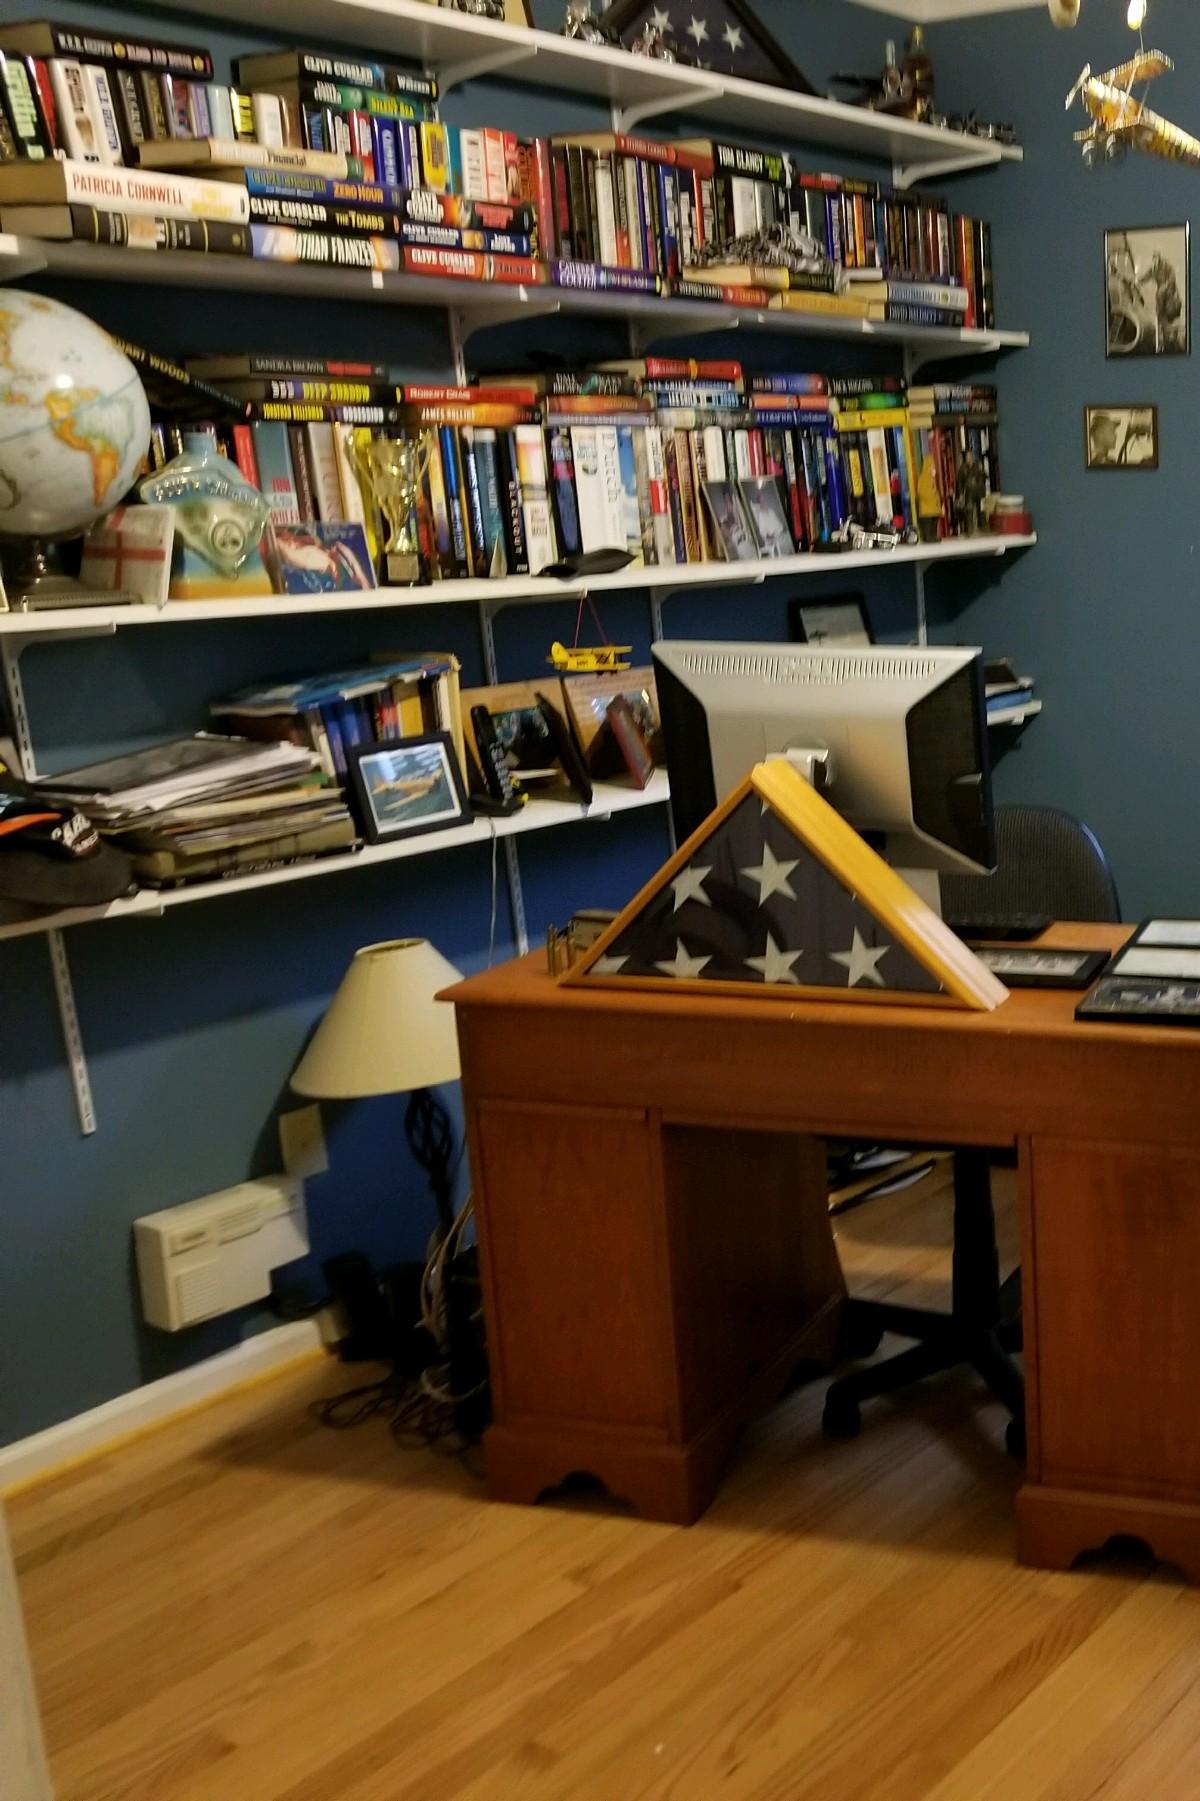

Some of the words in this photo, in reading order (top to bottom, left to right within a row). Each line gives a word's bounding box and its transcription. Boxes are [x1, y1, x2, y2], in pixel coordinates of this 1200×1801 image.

[304, 55, 332, 76] CLIVE
[333, 60, 374, 88] CUSSLER
[268, 152, 307, 167] Financial
[718, 145, 736, 165] TOM
[737, 150, 764, 173] CLANCY
[72, 173, 123, 198] PATRICIA
[127, 180, 184, 206] CORNWELL
[333, 182, 357, 200] ZERO
[358, 185, 384, 204] HOUR
[251, 197, 281, 215] CLIVE
[281, 200, 327, 222] CUSSLER
[349, 209, 385, 232] TOMBS
[331, 236, 376, 268] FRANZEN
[411, 247, 438, 265] CLIVE
